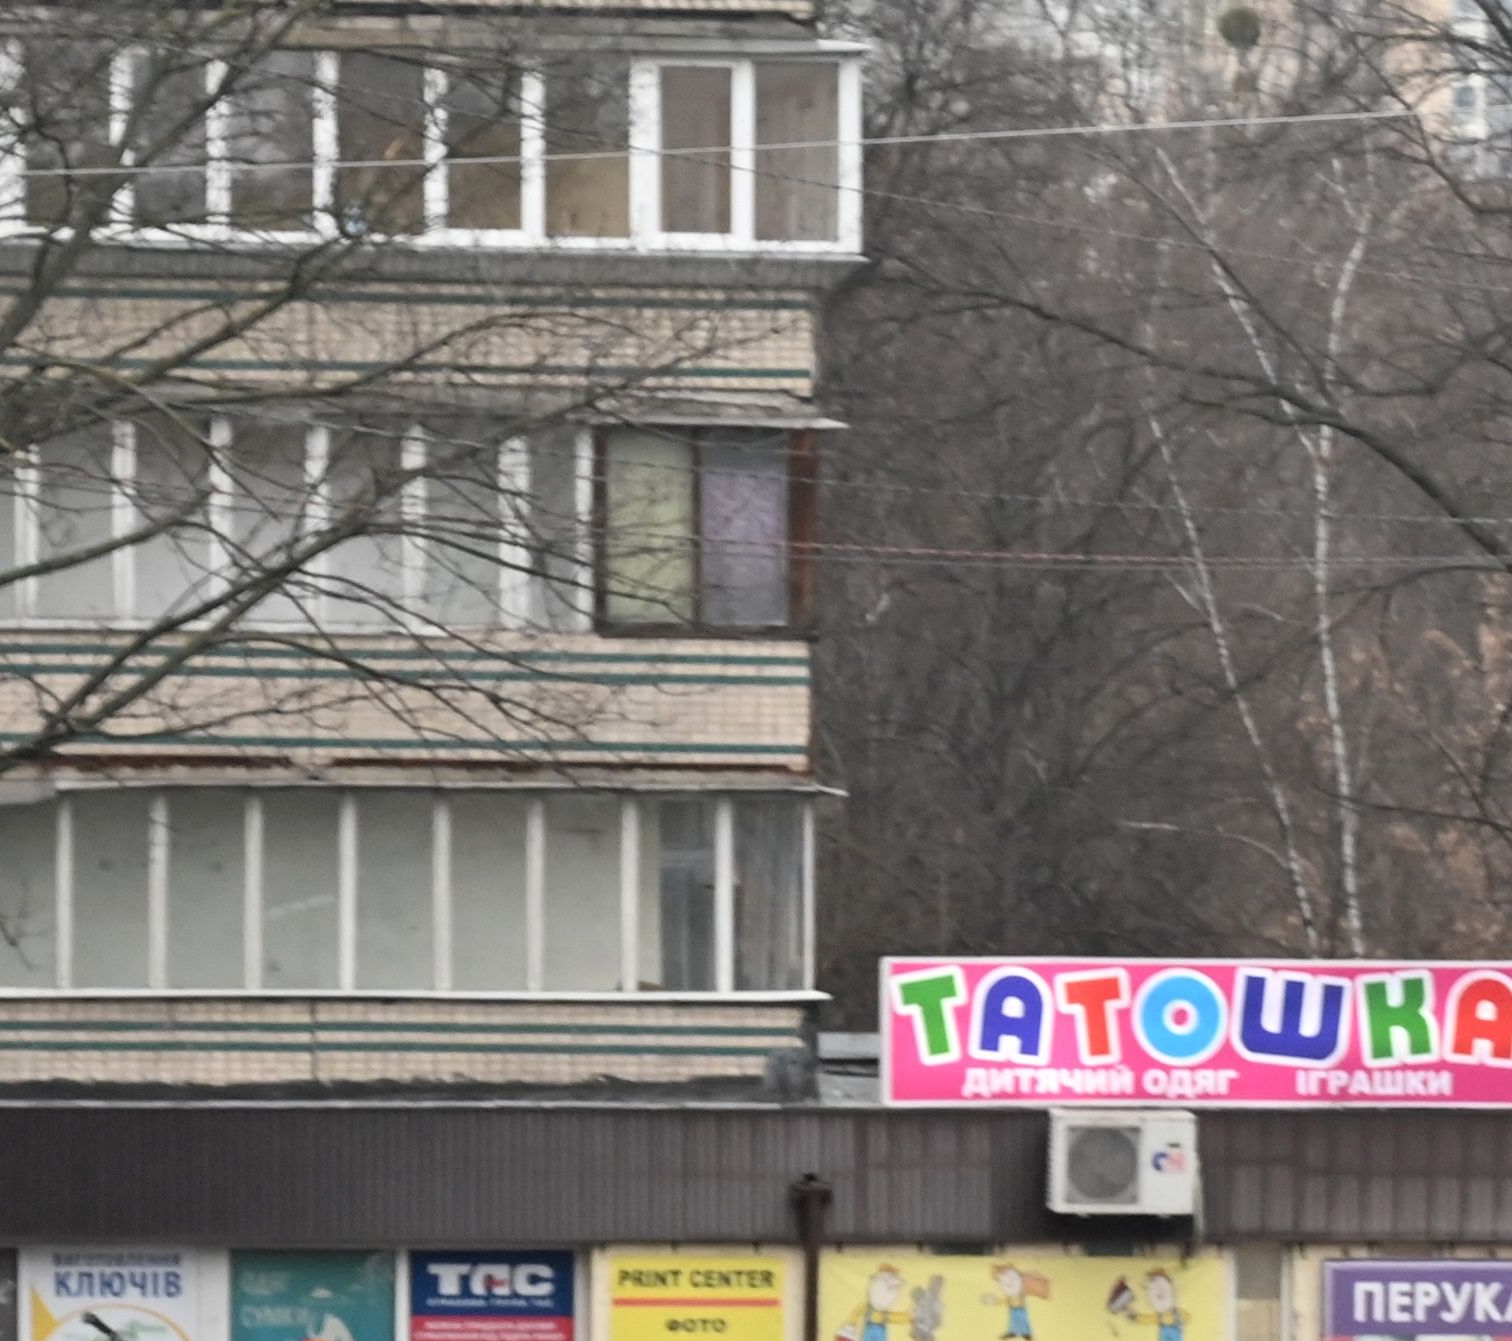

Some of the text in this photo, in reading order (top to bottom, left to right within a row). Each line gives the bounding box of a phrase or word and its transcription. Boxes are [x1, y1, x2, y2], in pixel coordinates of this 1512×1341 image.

[961, 1065, 1453, 1098] ДИТЯЧИЙ ОДЯГ ІГРАШКИ
[54, 1270, 183, 1298] КЛЮЧІВ
[427, 1263, 556, 1297] ТАС
[618, 1269, 775, 1288] PRINT CENTER
[665, 1318, 728, 1333] ФОТО
